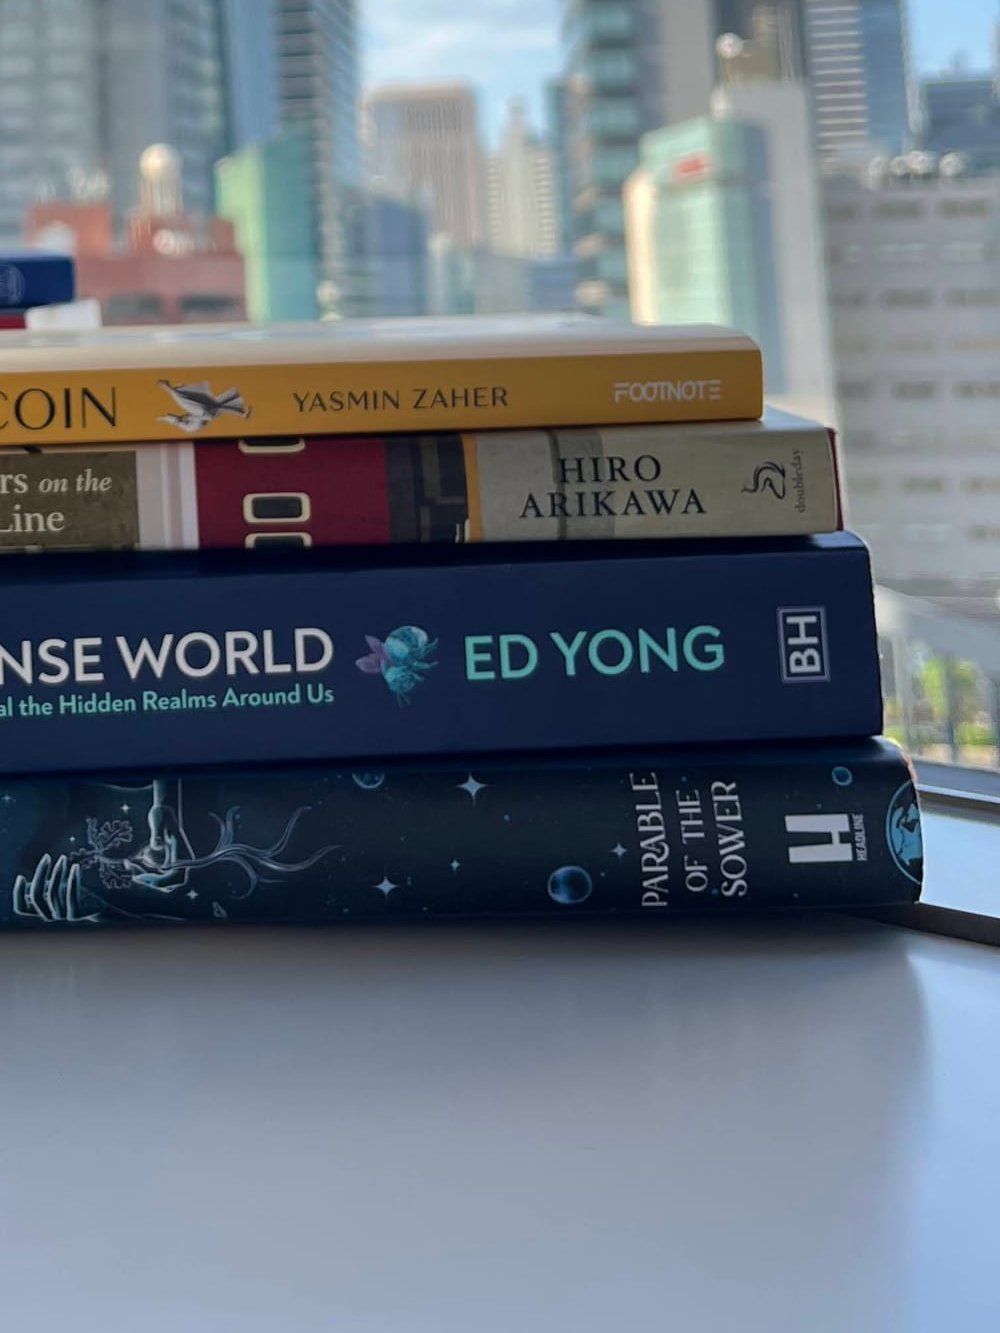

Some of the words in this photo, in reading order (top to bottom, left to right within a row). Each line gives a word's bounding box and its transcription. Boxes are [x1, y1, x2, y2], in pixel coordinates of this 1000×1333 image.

[293, 388, 400, 413] YASMIN
[413, 385, 509, 410] ZAHER
[613, 379, 721, 403] FOOTNOTE
[38, 476, 69, 494] on
[76, 468, 113, 493] the
[558, 454, 662, 484] HIRO
[519, 488, 708, 520] ARIKAWA
[115, 627, 335, 680] WORLD
[464, 633, 539, 681] ED
[549, 624, 725, 677] YONG
[785, 614, 821, 674] BH
[18, 695, 54, 717] the
[59, 691, 137, 715] Hidden
[143, 687, 218, 711] Realms
[222, 683, 301, 708] Around
[307, 682, 335, 704] Us
[629, 772, 670, 907] PARABLE
[675, 789, 706, 845] THE
[710, 780, 748, 897] SOWER
[784, 813, 853, 864] H
[851, 813, 868, 862] HEADLINE
[683, 855, 709, 893] OF
